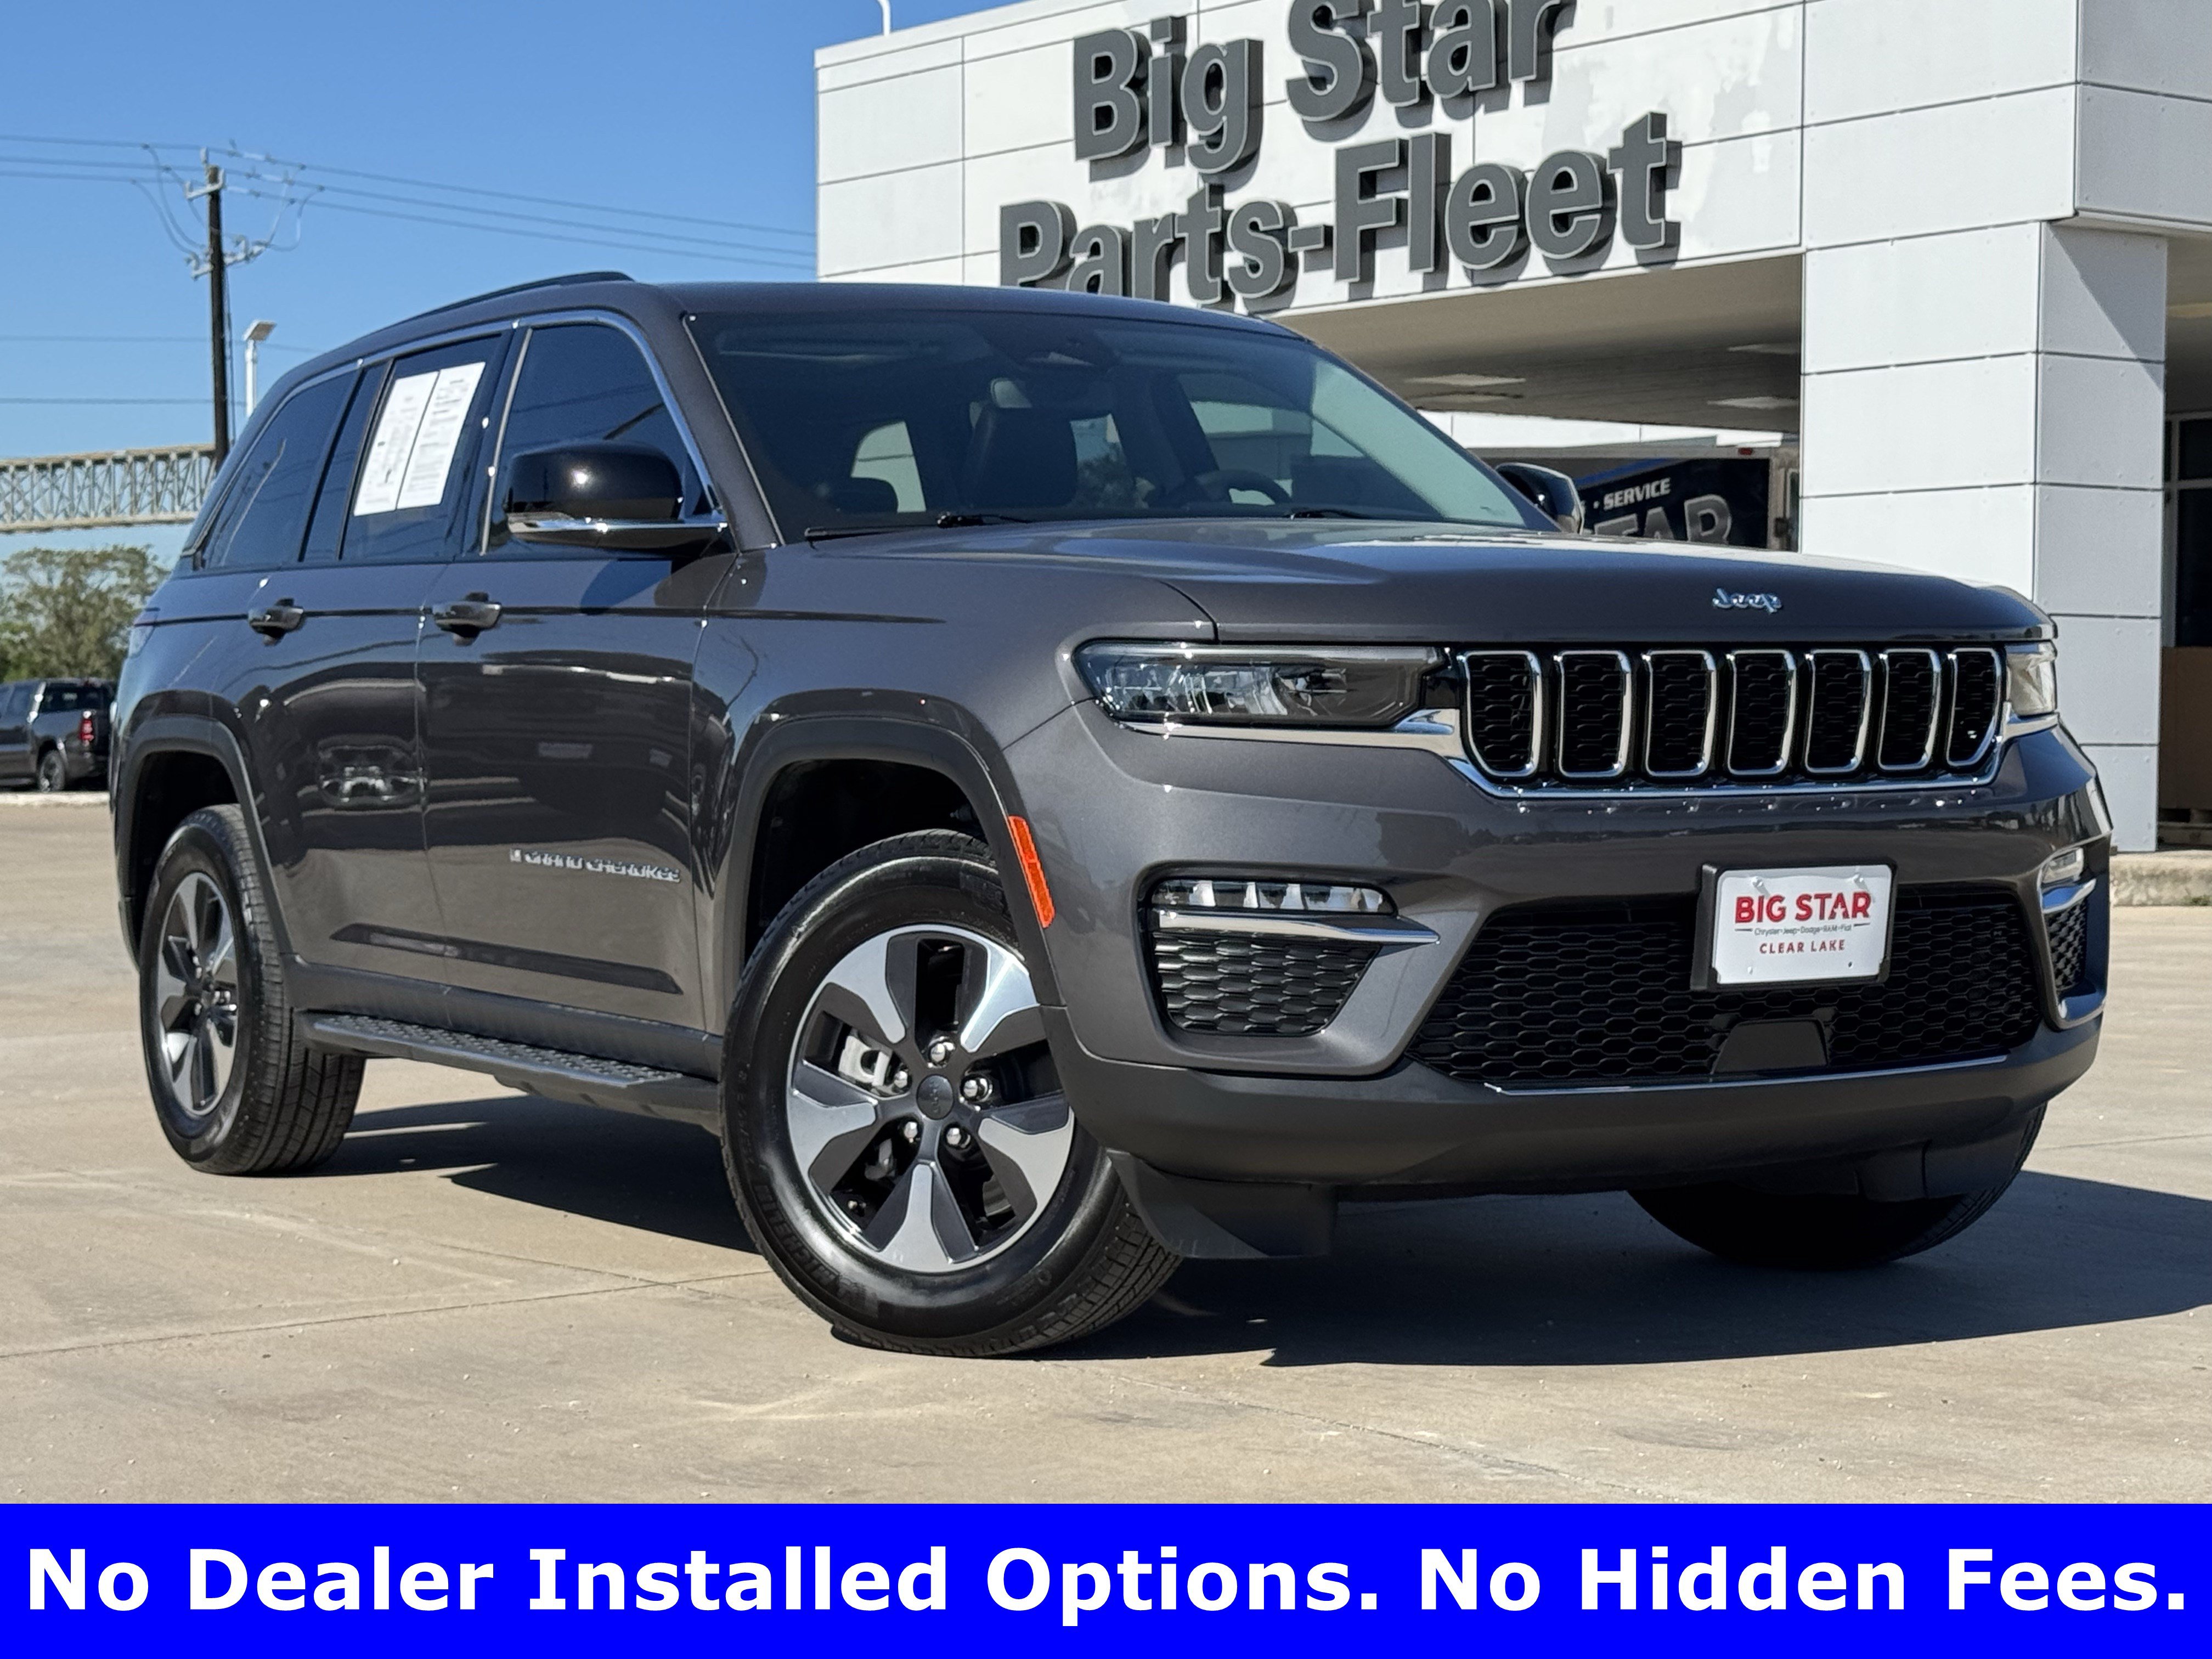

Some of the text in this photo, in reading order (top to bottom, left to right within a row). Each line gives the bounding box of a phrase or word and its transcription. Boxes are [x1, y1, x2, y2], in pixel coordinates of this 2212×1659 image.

[1073, 0, 1570, 174] Big Star
[1000, 112, 1678, 300] Parts-Fleet
[1603, 477, 1671, 511] SERVICE
[1712, 588, 1782, 613] Jeep
[586, 859, 680, 882] CHEROKEE
[1735, 891, 1872, 924] BIG STAR
[1759, 939, 1846, 954] CLEAR LAKE
